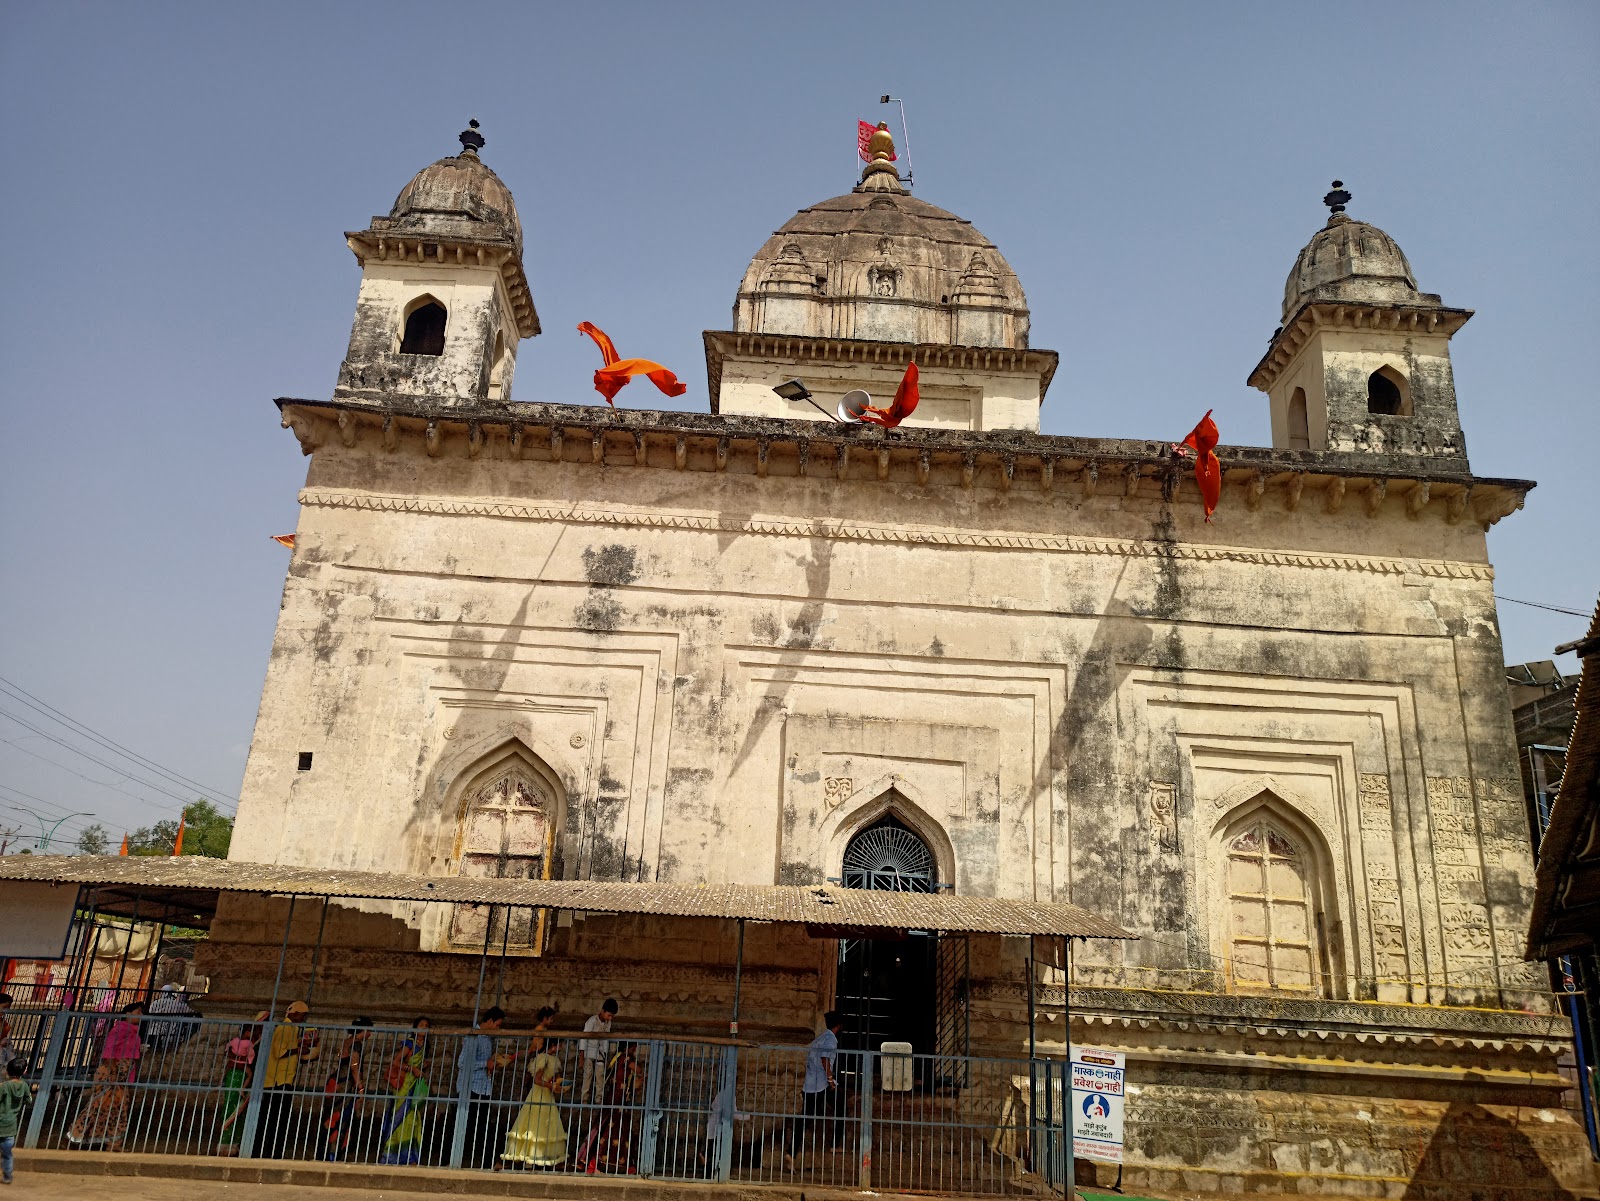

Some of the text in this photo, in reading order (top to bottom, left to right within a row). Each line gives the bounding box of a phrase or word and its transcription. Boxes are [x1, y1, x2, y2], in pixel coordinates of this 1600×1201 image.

[1074, 1067, 1121, 1081] मास्क नाही
[1073, 1076, 1121, 1093] प्रवेश नाही
[1083, 1121, 1107, 1131] माझे कुटुंब
